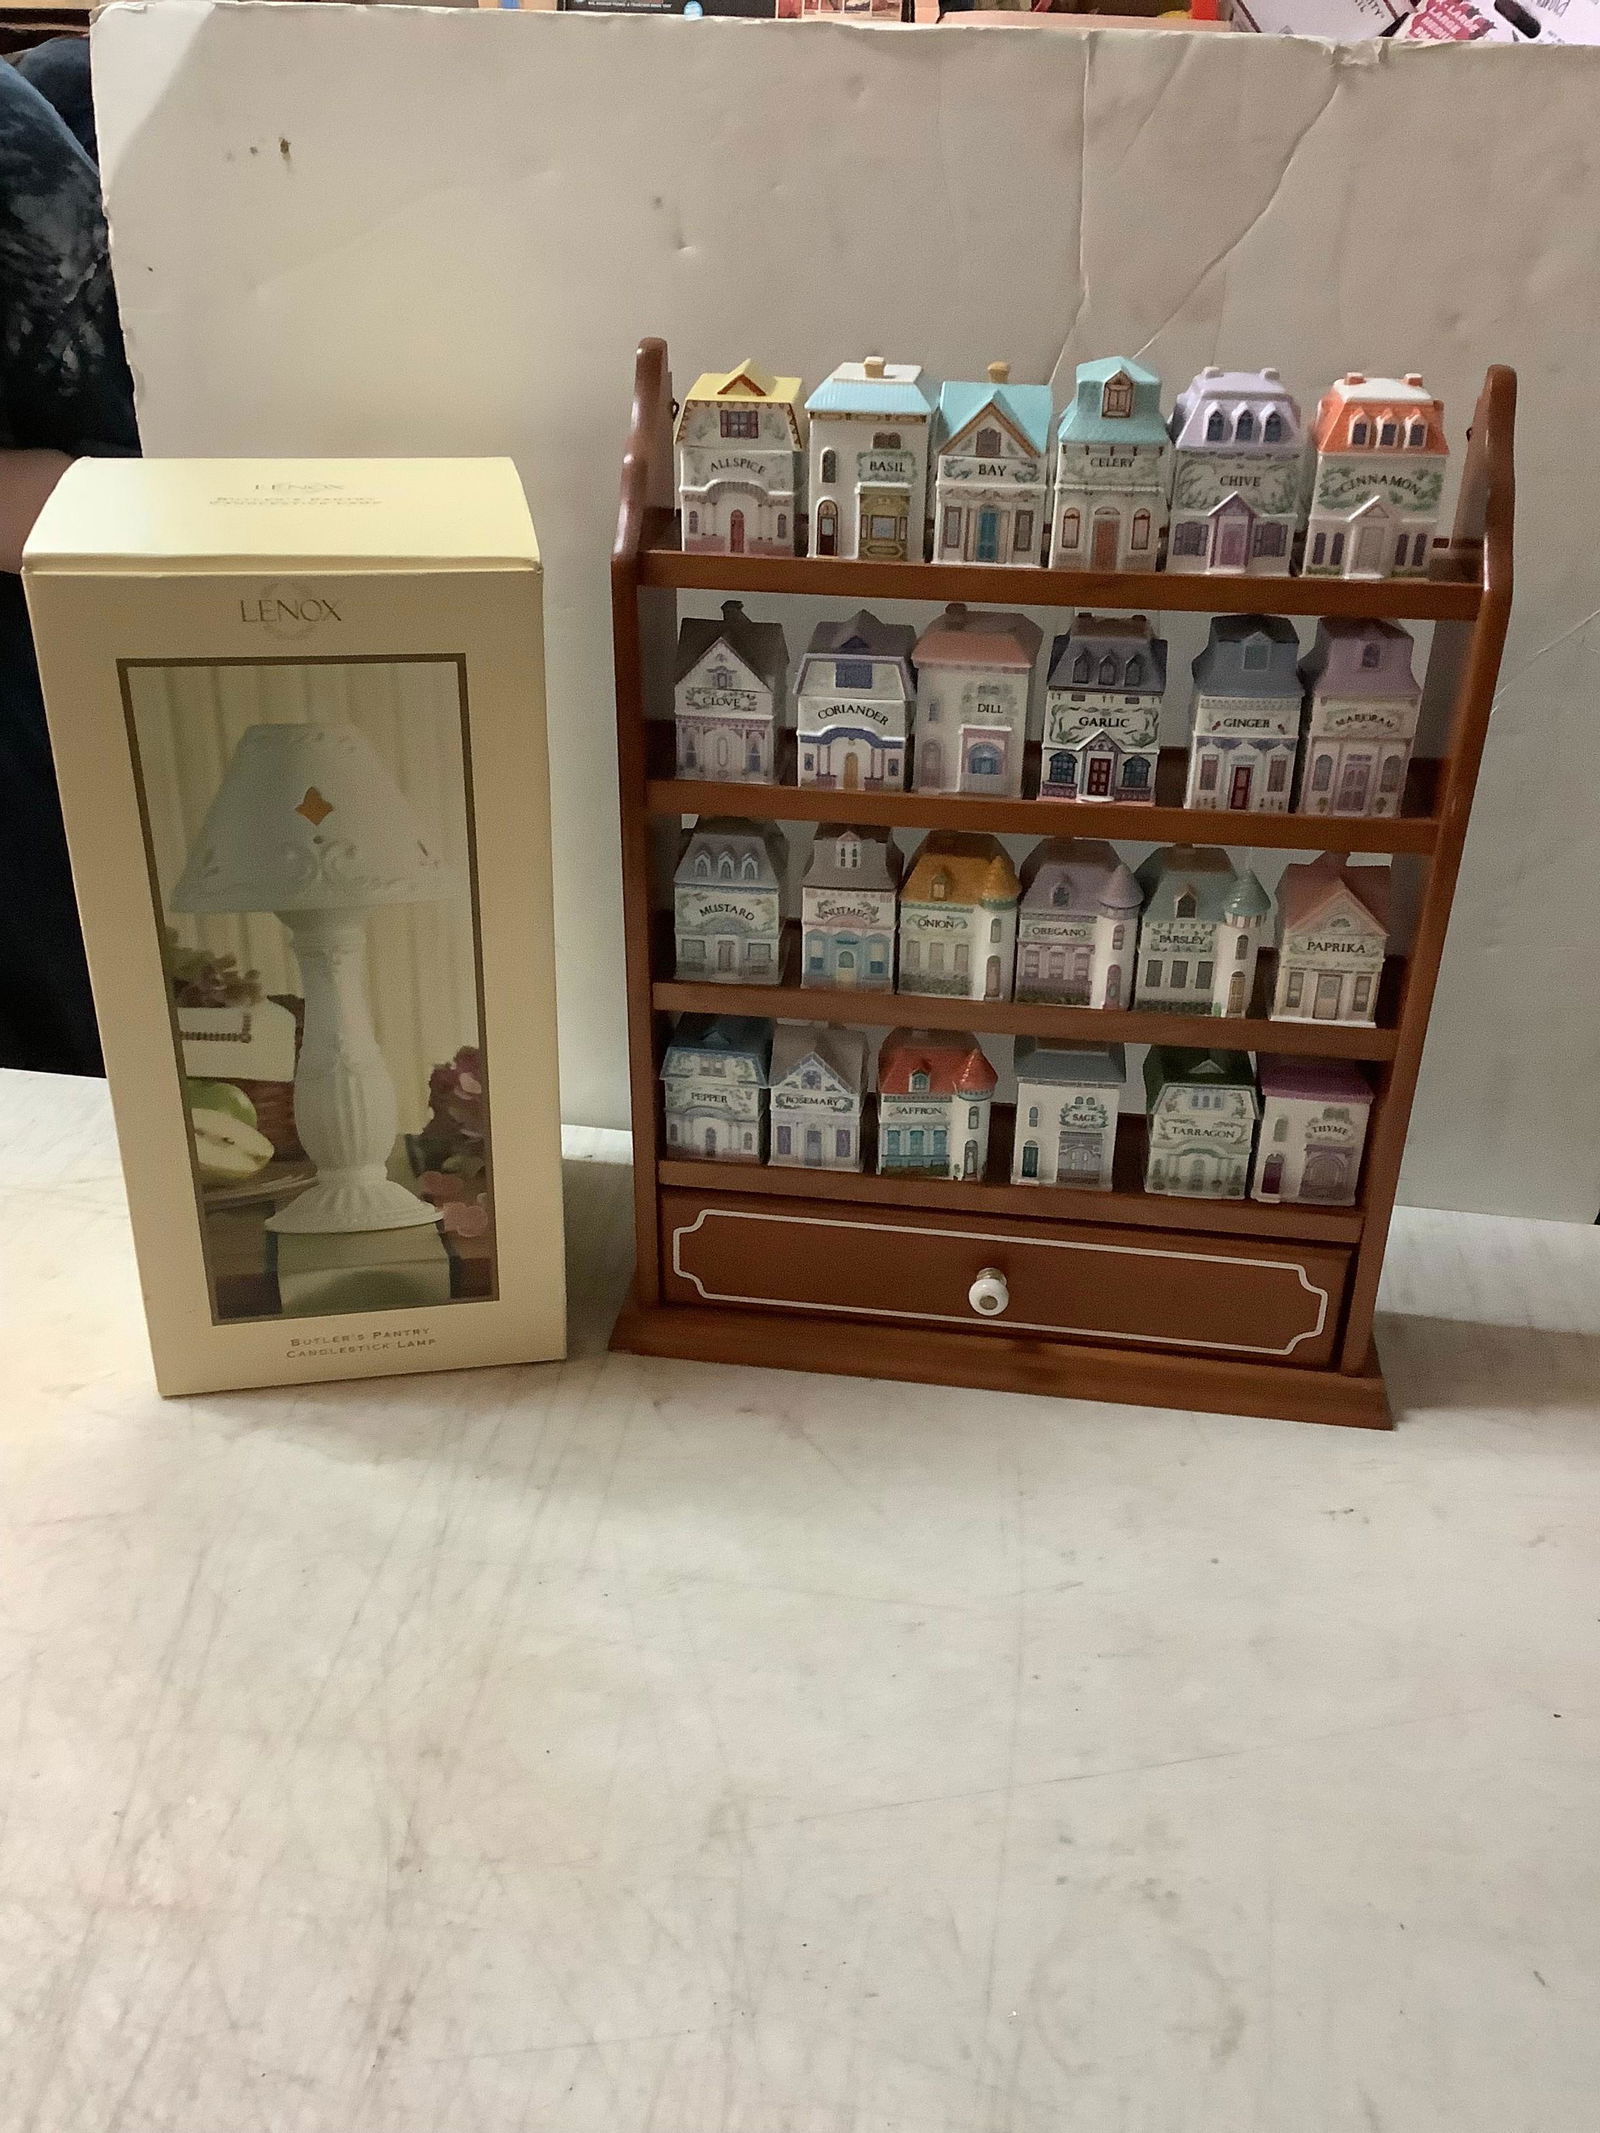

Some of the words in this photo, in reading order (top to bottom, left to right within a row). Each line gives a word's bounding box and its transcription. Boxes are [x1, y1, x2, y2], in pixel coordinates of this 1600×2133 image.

[710, 457, 767, 474] ALLSPICE
[869, 461, 906, 473] BASIL
[1090, 457, 1135, 468] CELERY
[978, 464, 1007, 477] BAY
[1219, 474, 1261, 488] CHIVE
[1340, 475, 1421, 495] CINNAMON
[240, 599, 342, 622] LENOX
[702, 696, 741, 708] CLOVE
[977, 703, 1004, 714] DILL
[817, 703, 889, 726] CORIANDER
[1078, 716, 1131, 729] GARLIC
[1223, 717, 1271, 729] GINGER
[699, 903, 755, 922] MUSTARD
[823, 906, 868, 920] NUTMEG
[917, 918, 954, 930] ONION
[1032, 926, 1087, 937] OREGANO
[1159, 933, 1206, 946] PARSLEY
[1306, 941, 1367, 954] PAPRIKA
[691, 1091, 728, 1104] PEPPER
[785, 1096, 838, 1107] ROSEMARY
[896, 1106, 943, 1116] SAFFRON
[1072, 1113, 1097, 1122] SAGE
[1172, 1125, 1235, 1140] TARRAGON
[1311, 1125, 1348, 1136] THYME
[291, 1334, 365, 1347] BUTLER'S
[373, 1328, 430, 1339] PANTRY
[286, 1344, 390, 1359] CANDLESTICK
[397, 1338, 437, 1349] LAMP
